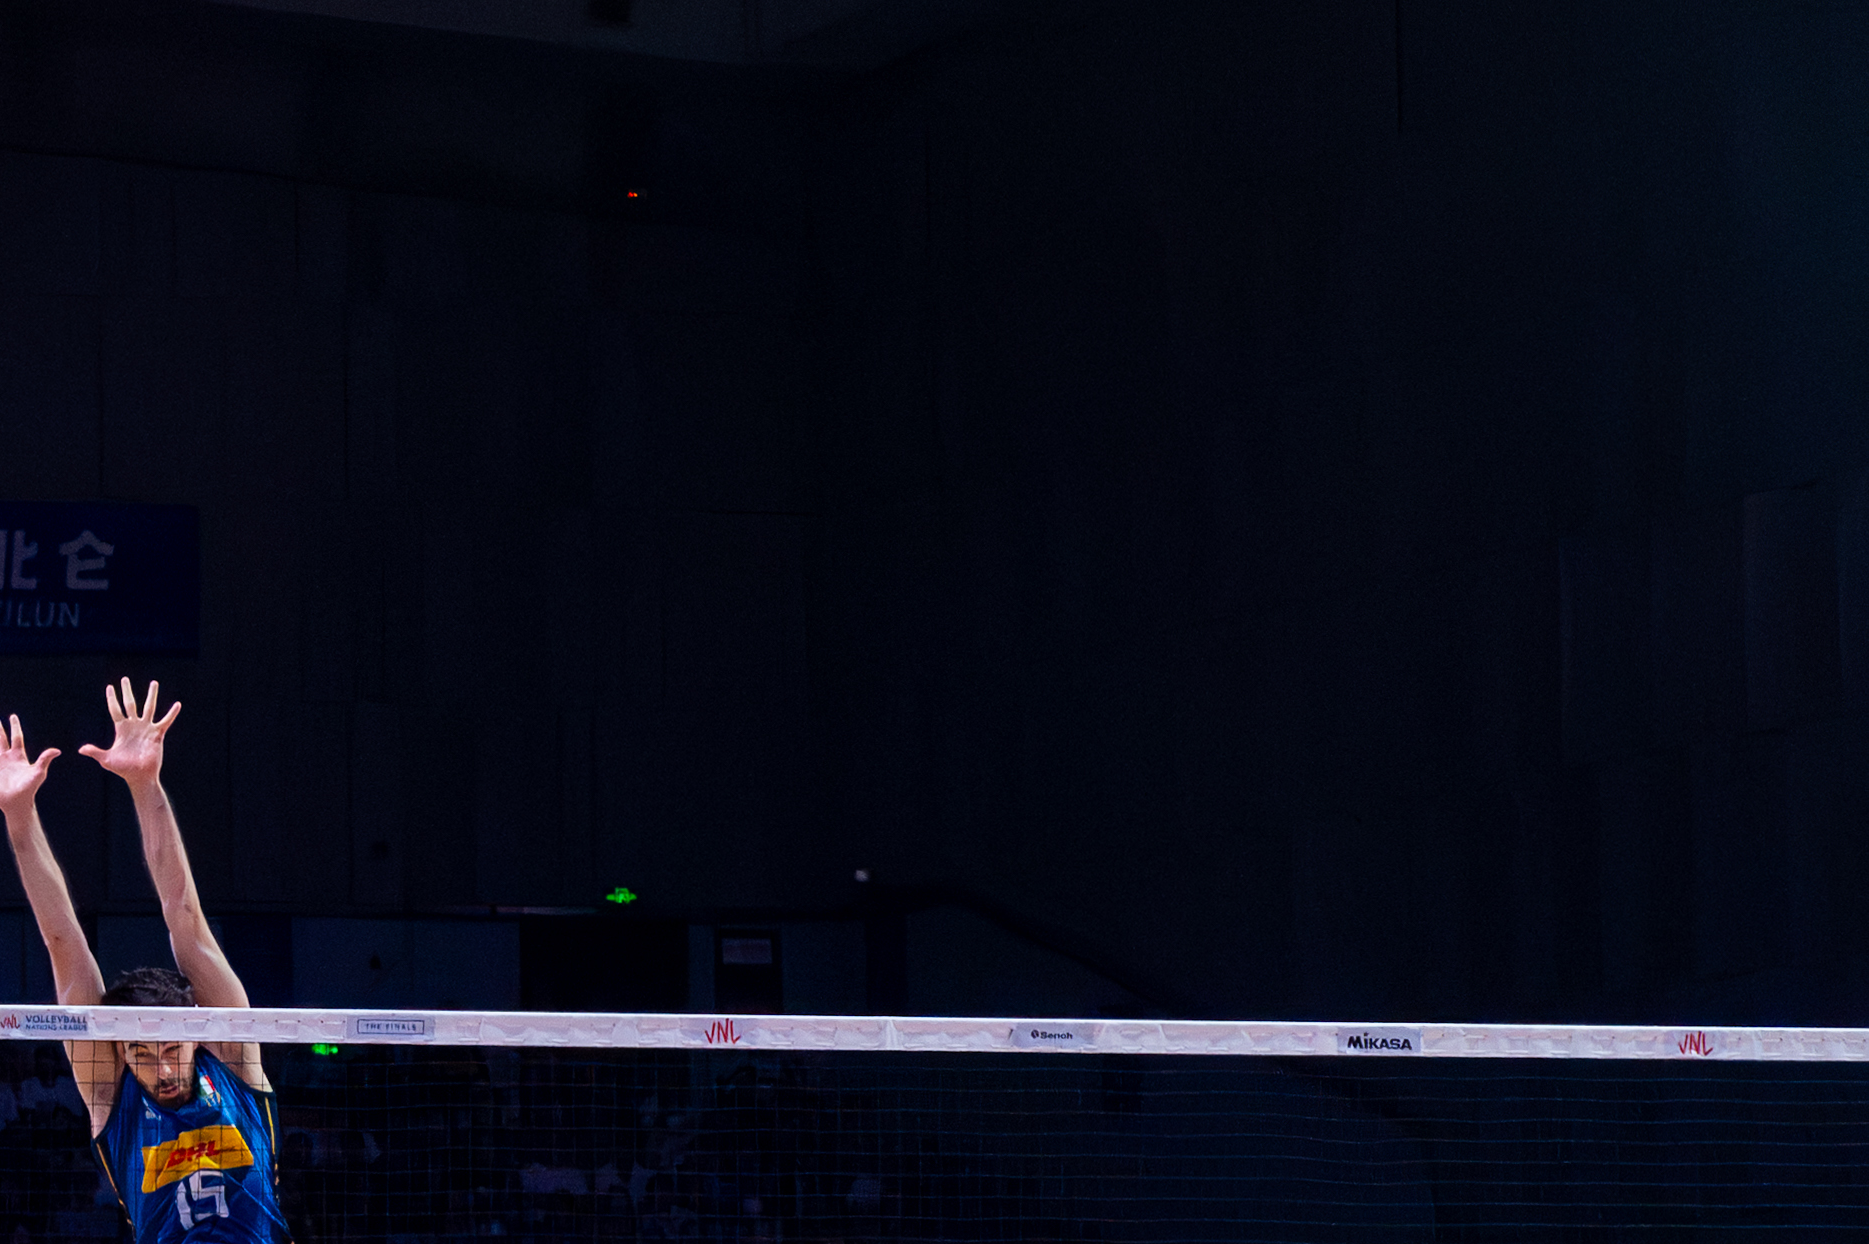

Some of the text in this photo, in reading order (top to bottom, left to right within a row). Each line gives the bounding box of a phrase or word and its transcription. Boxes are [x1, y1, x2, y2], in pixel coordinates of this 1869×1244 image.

[0, 1014, 20, 1029] VNL
[25, 1015, 87, 1024] VOLLEYBALL
[385, 1023, 416, 1031] FINALS
[704, 1019, 741, 1044] VNL
[1039, 1031, 1073, 1040] Senoh
[1678, 1031, 1713, 1056] VNL
[176, 1170, 229, 1230] 15
